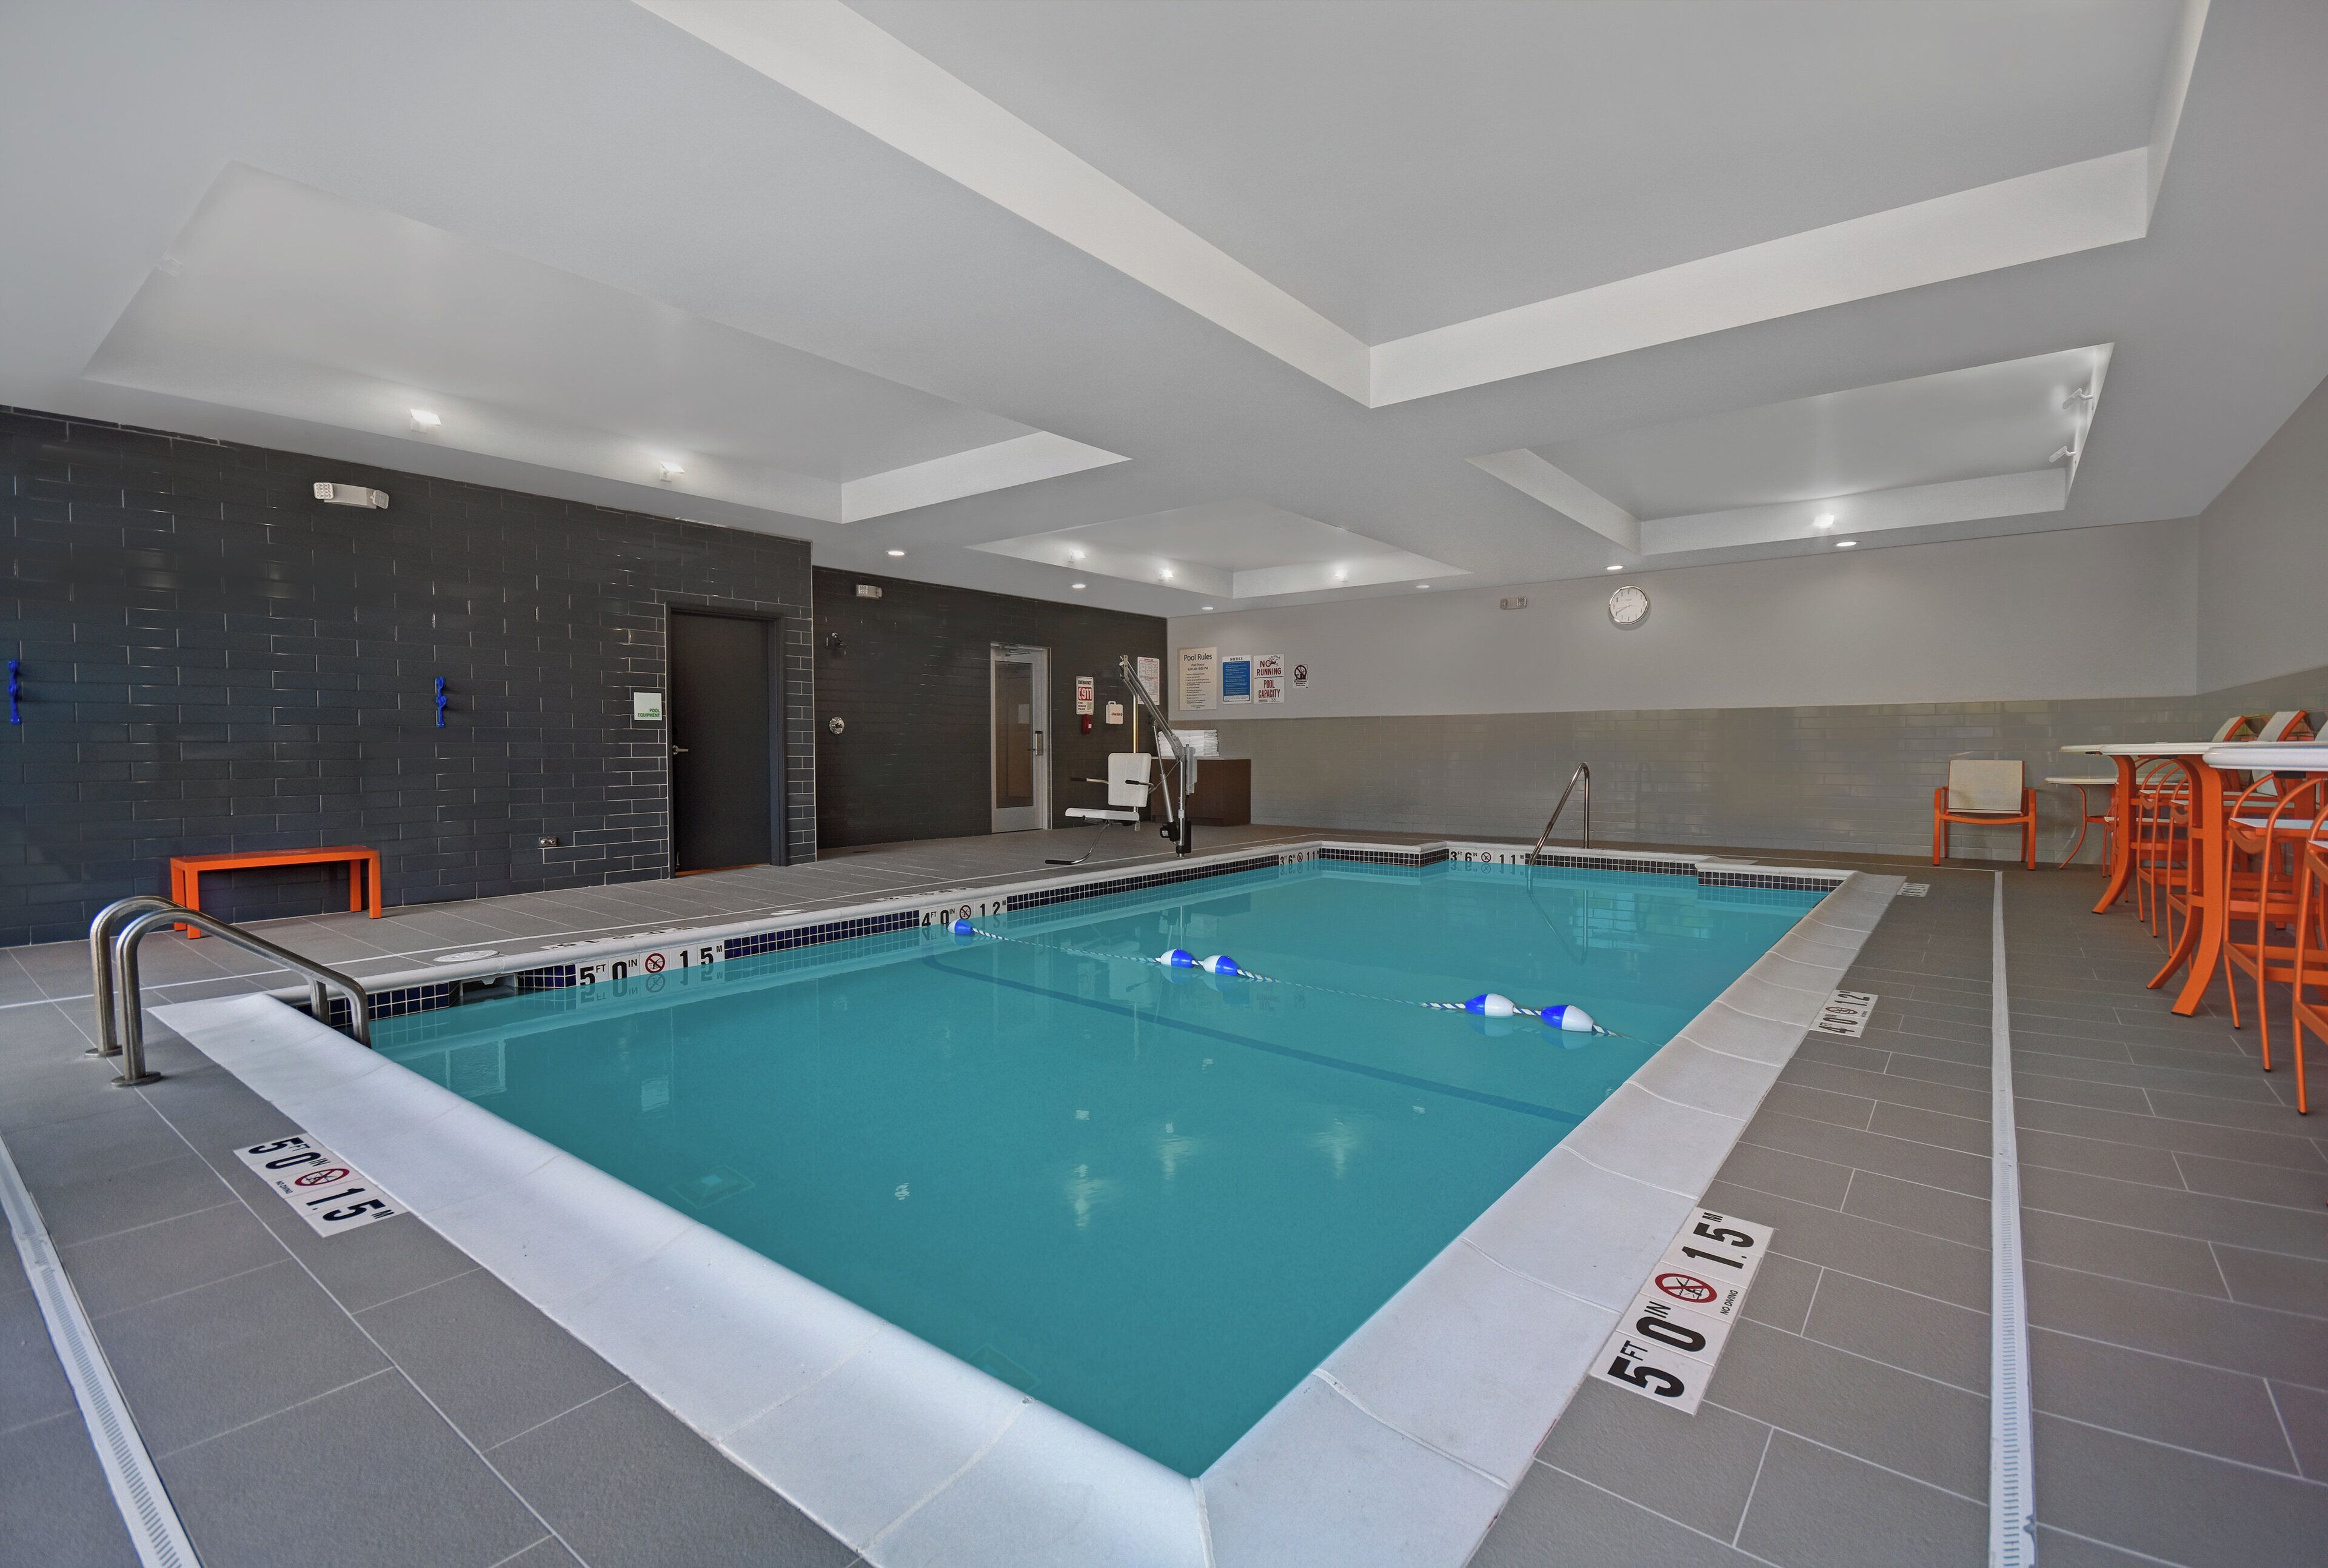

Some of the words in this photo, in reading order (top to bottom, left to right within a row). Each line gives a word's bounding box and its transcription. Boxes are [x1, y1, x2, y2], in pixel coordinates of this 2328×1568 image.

[1264, 679, 1274, 689] POOL
[1082, 687, 1092, 699] 911
[1258, 689, 1280, 698] CAPACITY
[1724, 1290, 1738, 1306] DIVING
[1721, 1306, 1730, 1315] NO
